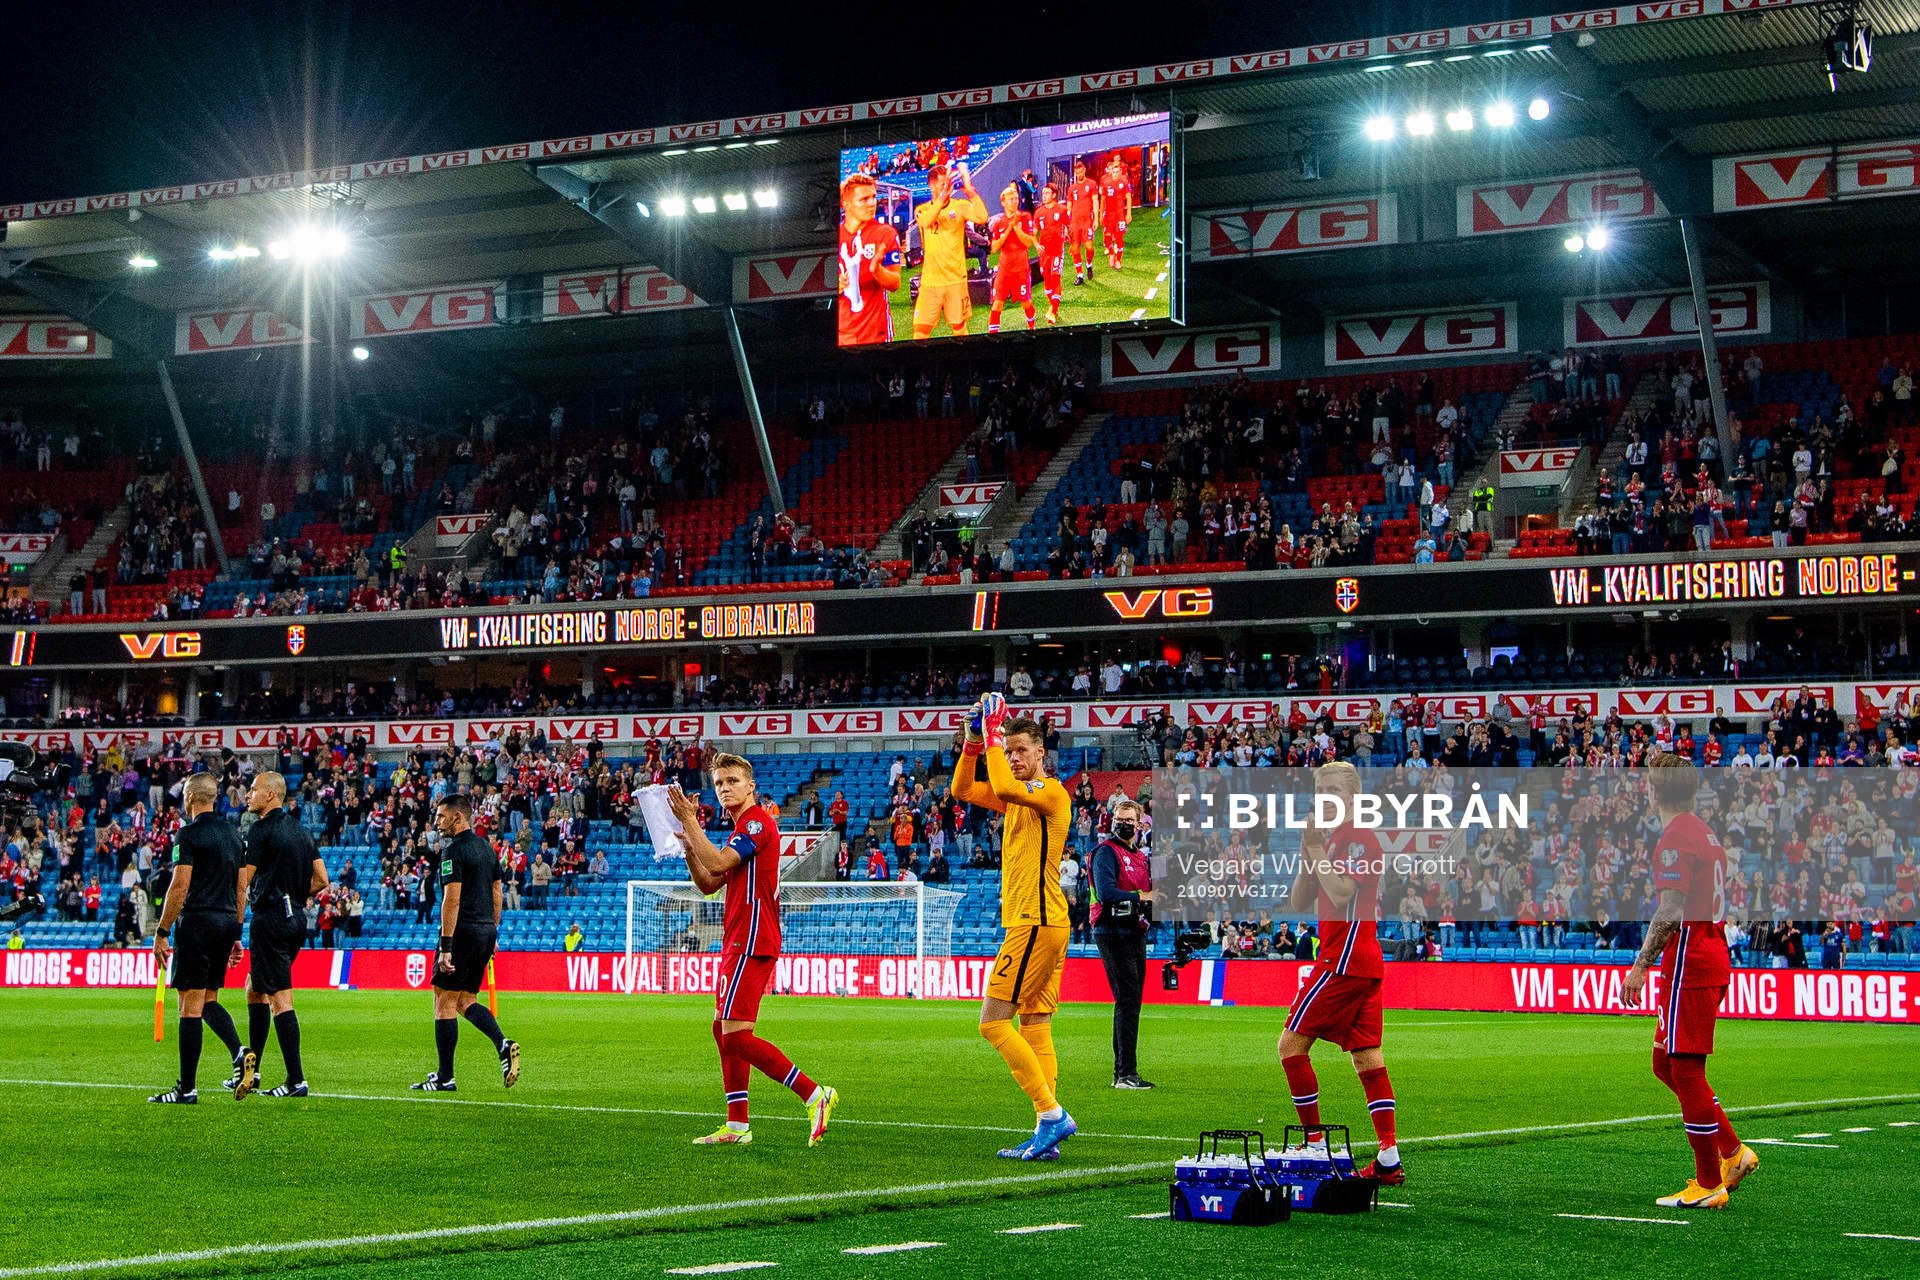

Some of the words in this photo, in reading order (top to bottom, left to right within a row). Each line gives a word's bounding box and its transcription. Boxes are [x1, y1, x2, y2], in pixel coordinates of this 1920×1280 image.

[1638, 1, 1699, 20] VG
[1554, 12, 1613, 30] VG
[1469, 21, 1528, 40] VG
[1389, 31, 1446, 50] VG
[1310, 42, 1366, 61] VG
[1232, 52, 1287, 70] VG
[1156, 62, 1211, 80] VG
[1010, 81, 1061, 98] VG
[1083, 72, 1135, 89] VG
[870, 98, 918, 115] VG
[940, 90, 989, 107] VG
[737, 115, 784, 131] VG
[803, 107, 850, 123] VG
[671, 123, 719, 139] VG
[1066, 118, 1112, 134] ULLEVAAL
[545, 138, 590, 153] VG
[608, 131, 655, 146] VG
[424, 153, 467, 168] VG
[484, 146, 528, 161] VG
[313, 167, 350, 181] VG
[366, 160, 409, 175] VG
[1739, 149, 1915, 201] VG
[197, 182, 236, 197] VG
[252, 175, 293, 190] VG
[88, 195, 127, 209] VG
[143, 188, 182, 203] VG
[1478, 175, 1644, 228] VG
[0, 206, 22, 219] G
[35, 201, 74, 215] VG
[1215, 204, 1369, 251] VG
[891, 251, 900, 262] C
[754, 256, 838, 294] V
[562, 273, 686, 316] VG
[1020, 284, 1027, 296] 5
[367, 291, 487, 331] VG
[1581, 290, 1748, 339] VG
[1343, 310, 1498, 357] VG
[1117, 330, 1261, 373] VG
[1506, 452, 1575, 471] VG
[943, 487, 999, 503] VG
[1551, 561, 1785, 605] VM-KVALIFISERING
[1104, 587, 1213, 618] VG
[441, 611, 606, 649] VM-KVALIFISERING
[119, 631, 201, 659] VG
[1622, 691, 1707, 713] VG
[1859, 687, 1920, 709] V
[1191, 703, 1267, 723] VG
[1298, 701, 1369, 721] VG
[552, 719, 614, 738] VG
[637, 717, 699, 736] VG
[723, 715, 787, 734] VG
[811, 713, 877, 732] VG
[391, 724, 450, 742] VG
[993, 953, 1013, 978] 12
[1201, 1195, 1222, 1212] YT
